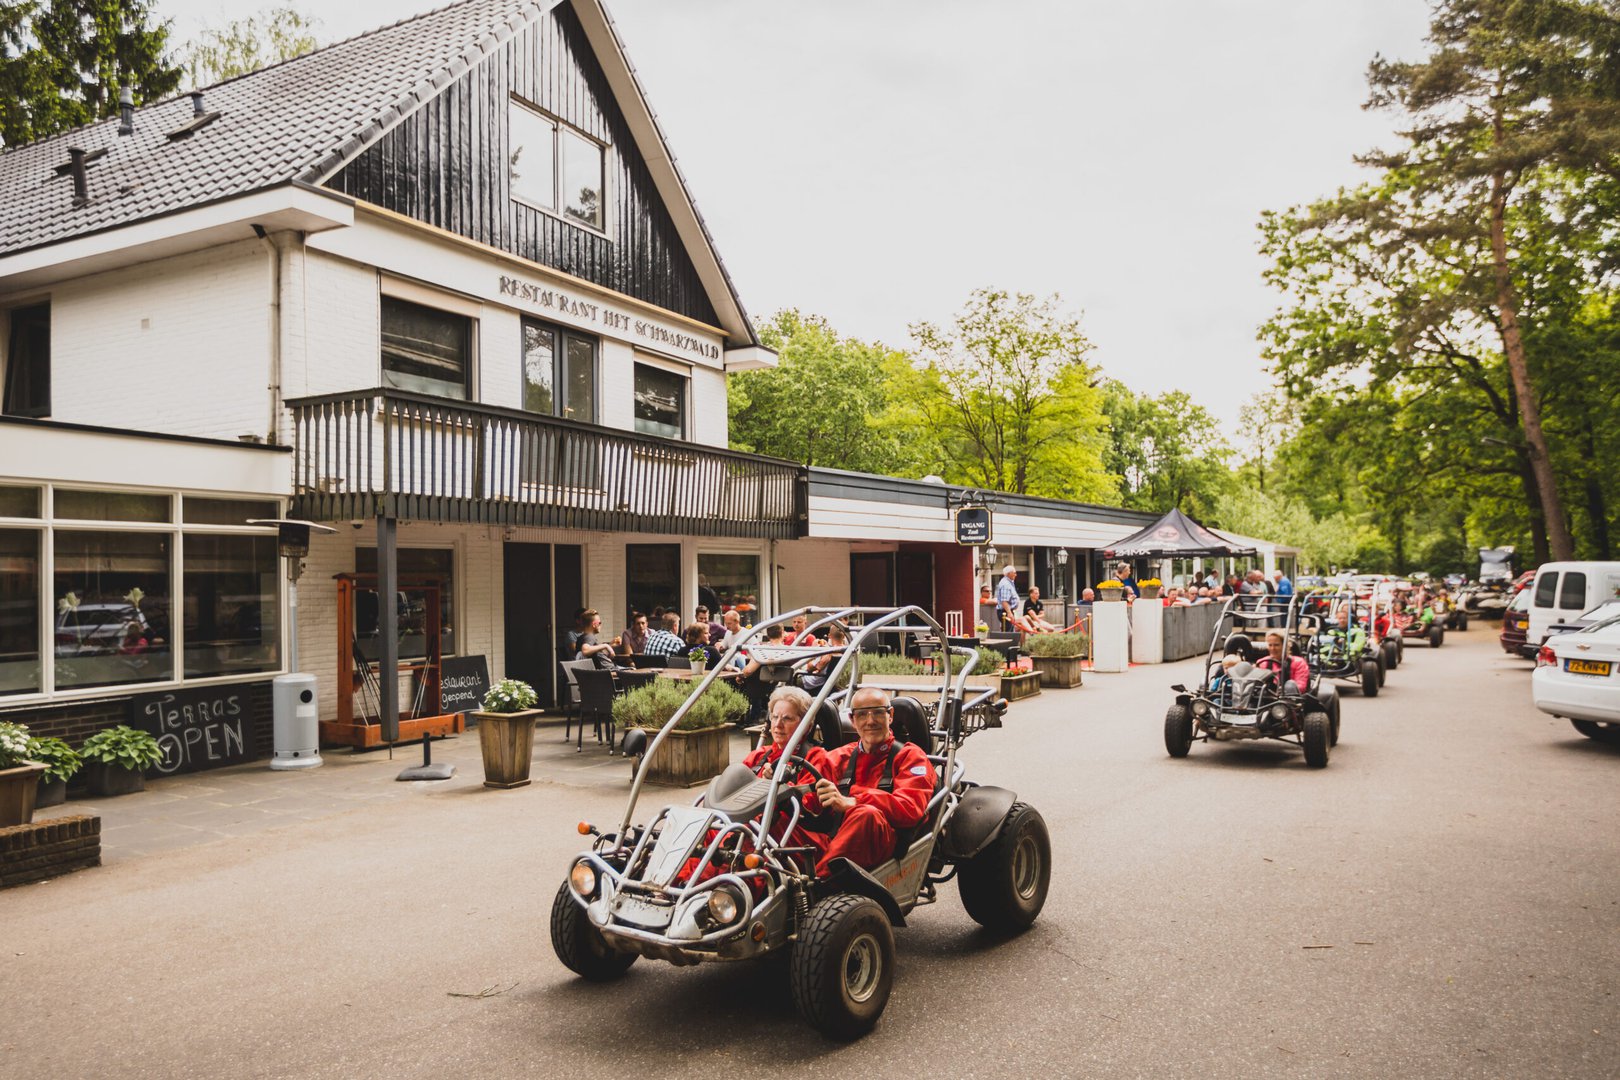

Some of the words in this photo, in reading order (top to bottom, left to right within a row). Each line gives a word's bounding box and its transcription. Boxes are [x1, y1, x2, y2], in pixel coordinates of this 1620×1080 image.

[499, 275, 599, 321] RESTAURANT
[603, 309, 630, 331] HET
[634, 320, 719, 360] SCHWARZWALD
[441, 690, 476, 709] geopend
[154, 719, 244, 773] OPEN
